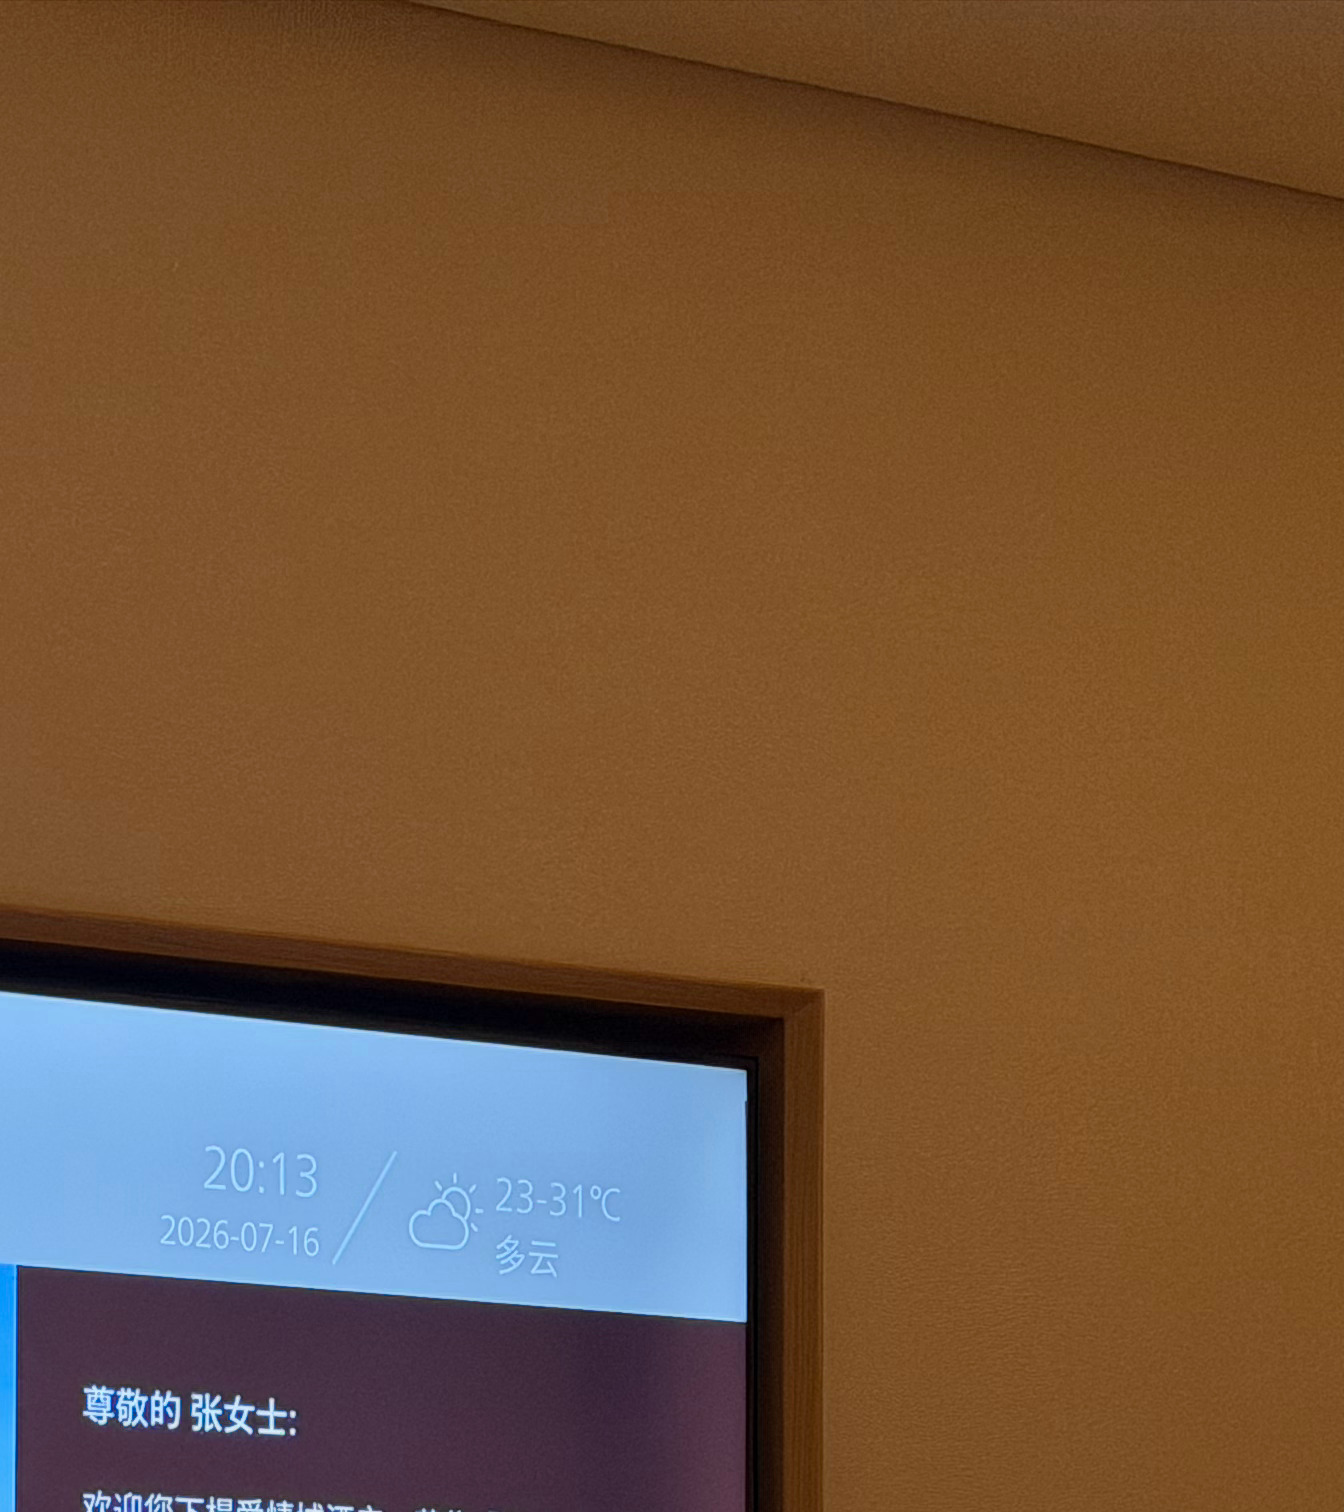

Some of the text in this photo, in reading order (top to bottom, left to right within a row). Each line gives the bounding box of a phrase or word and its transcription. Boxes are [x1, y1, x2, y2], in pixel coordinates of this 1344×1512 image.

[203, 1145, 318, 1198] 20:13
[160, 1214, 320, 1257] 2026-07-16
[495, 1235, 559, 1279] 多云
[82, 1385, 297, 1437] 尊敬的 张女士：
